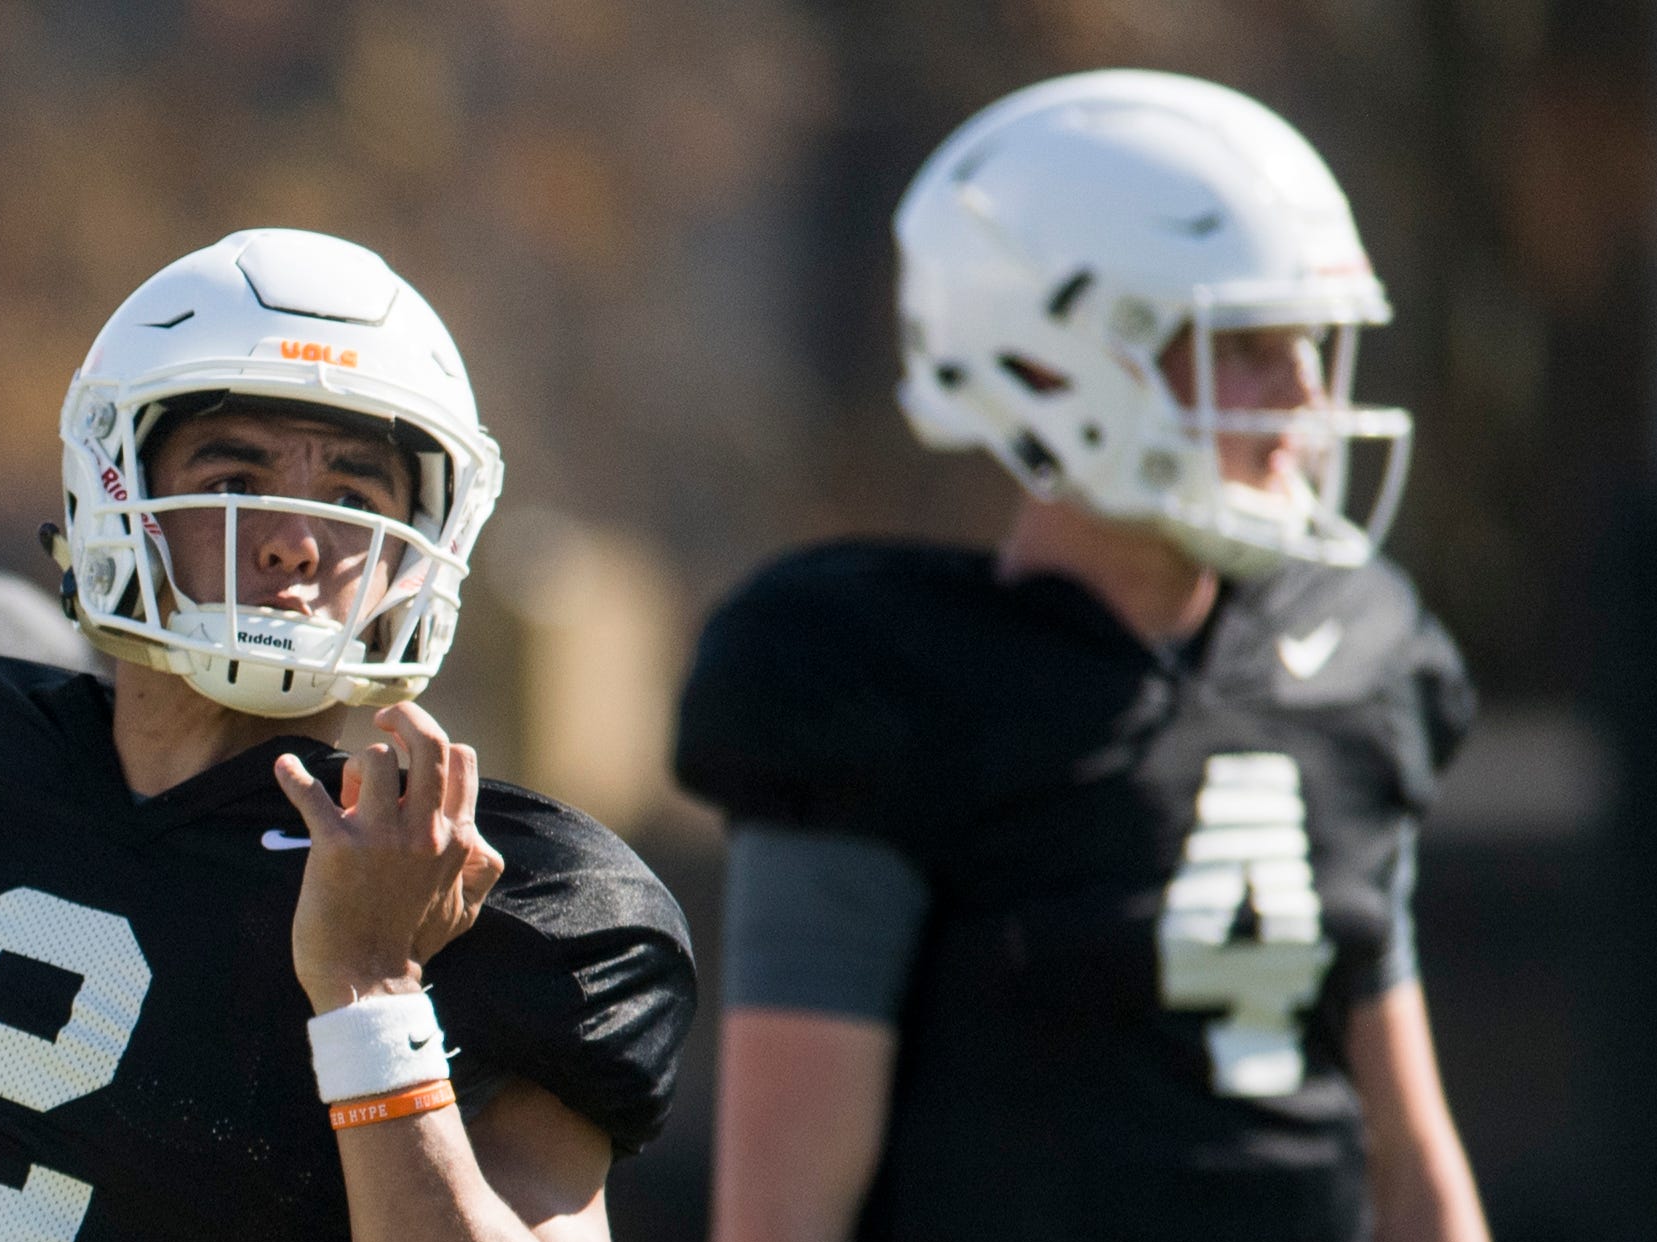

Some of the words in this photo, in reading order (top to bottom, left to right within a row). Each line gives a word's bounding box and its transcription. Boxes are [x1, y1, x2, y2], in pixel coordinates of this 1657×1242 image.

[237, 631, 294, 651] Riddell
[1157, 752, 1335, 1097] 4
[349, 1104, 388, 1124] HYPE
